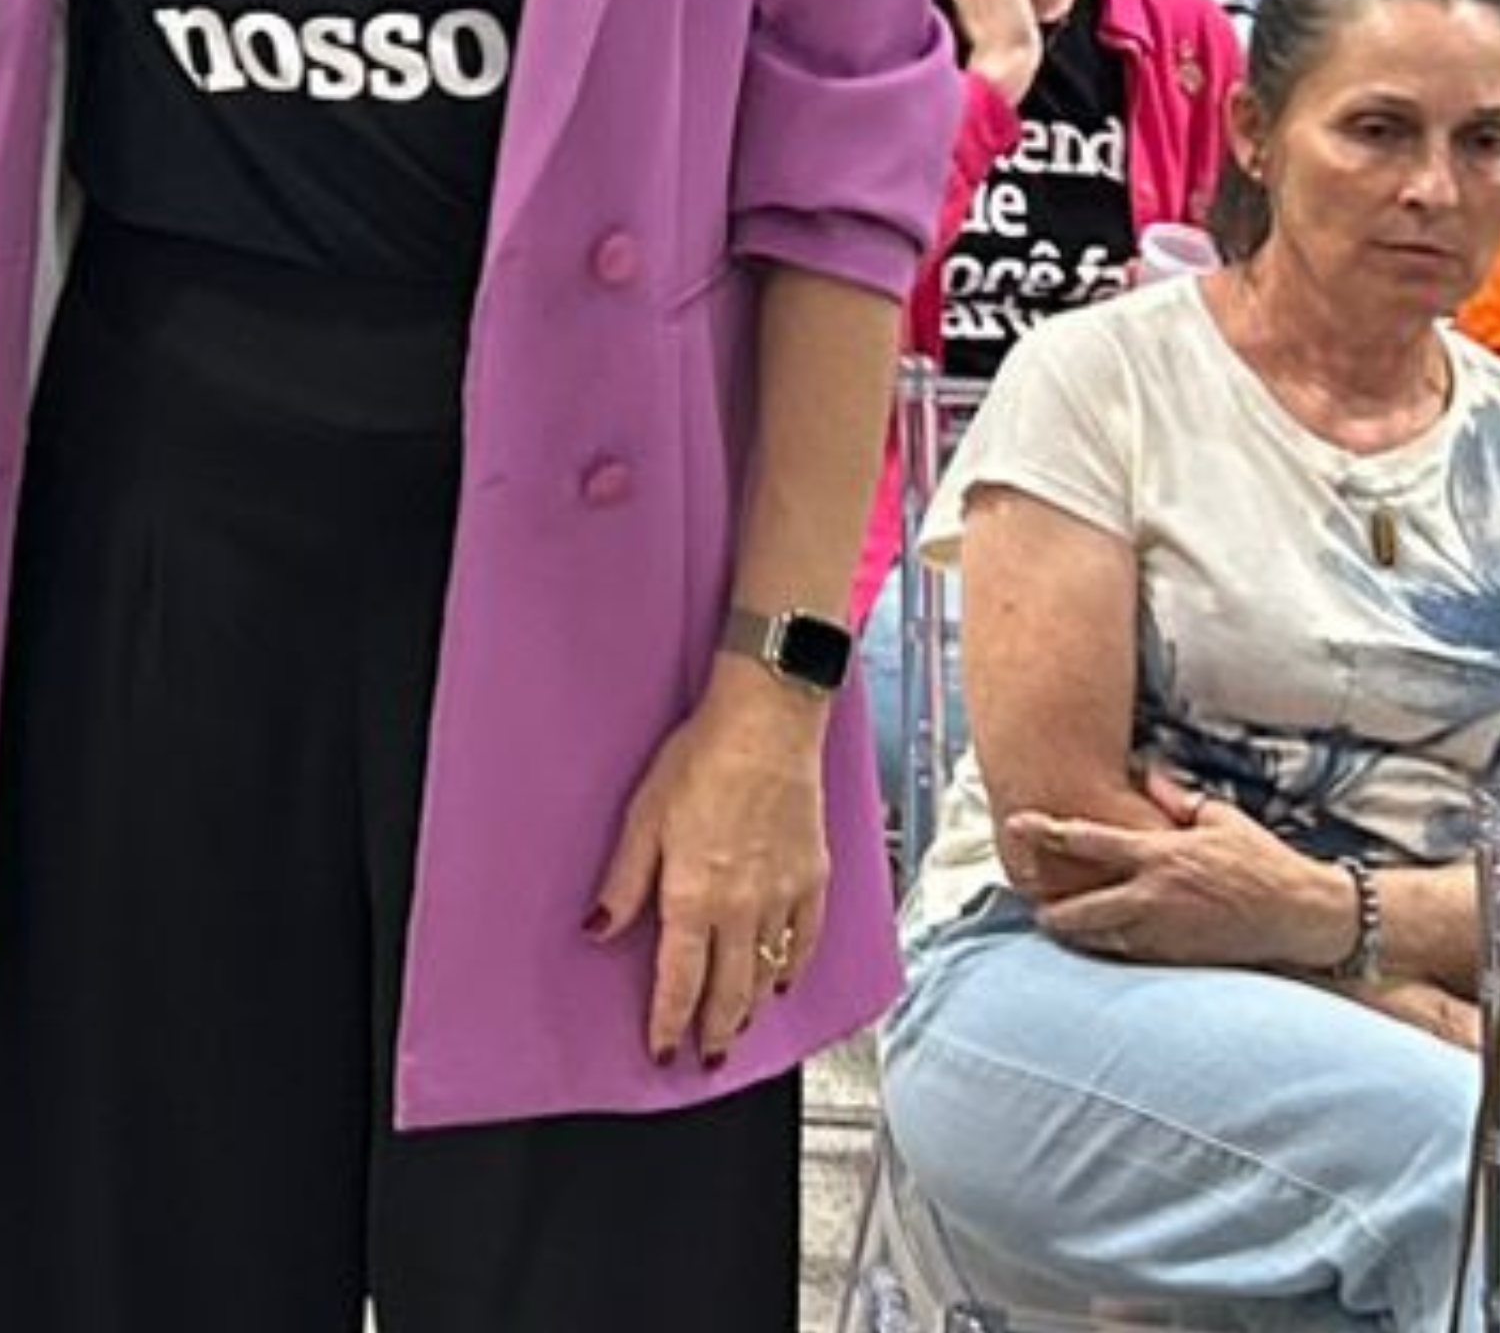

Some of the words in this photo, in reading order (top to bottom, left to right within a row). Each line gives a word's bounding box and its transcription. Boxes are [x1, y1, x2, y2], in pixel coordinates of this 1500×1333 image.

[152, 5, 509, 101] nosso
[993, 115, 1125, 183] end
[941, 239, 1066, 297] ocê
